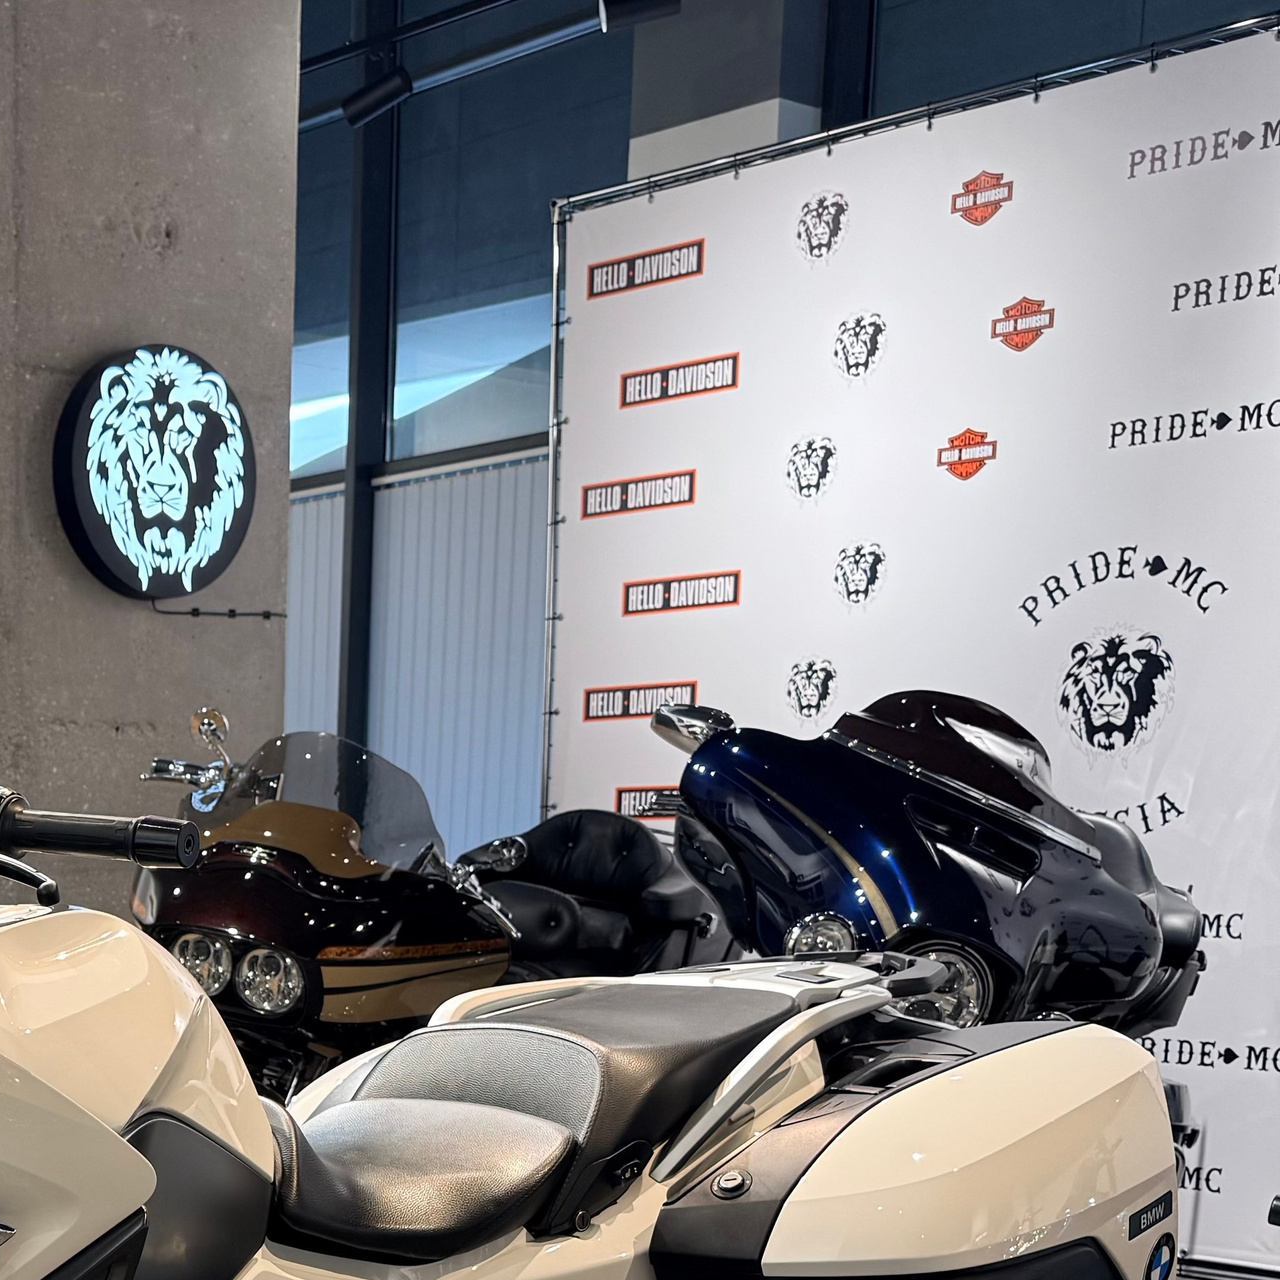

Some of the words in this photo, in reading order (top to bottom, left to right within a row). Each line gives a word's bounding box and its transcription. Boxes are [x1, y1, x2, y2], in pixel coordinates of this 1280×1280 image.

[1127, 127, 1231, 179] PRIDE
[592, 262, 628, 294] HELLO
[634, 245, 699, 285] DAVIDSON
[1171, 265, 1278, 312] PRIDE
[1008, 301, 1039, 316] MOTOR
[625, 372, 662, 403] HELLO
[668, 359, 734, 395] DAVIDSON
[1108, 408, 1210, 449] PRIDE
[587, 485, 621, 514] HELLO
[627, 475, 690, 508] DAVIDSON
[628, 583, 664, 612] HELLO
[670, 575, 735, 608] DAVIDSON
[1018, 545, 1138, 627] PRIDE
[1168, 557, 1229, 614] MC
[588, 691, 623, 717] HELLO
[1201, 913, 1244, 940] MC
[1141, 1037, 1216, 1069] RIDE
[1178, 1166, 1223, 1194] MC
[1141, 1202, 1165, 1230] BMW
